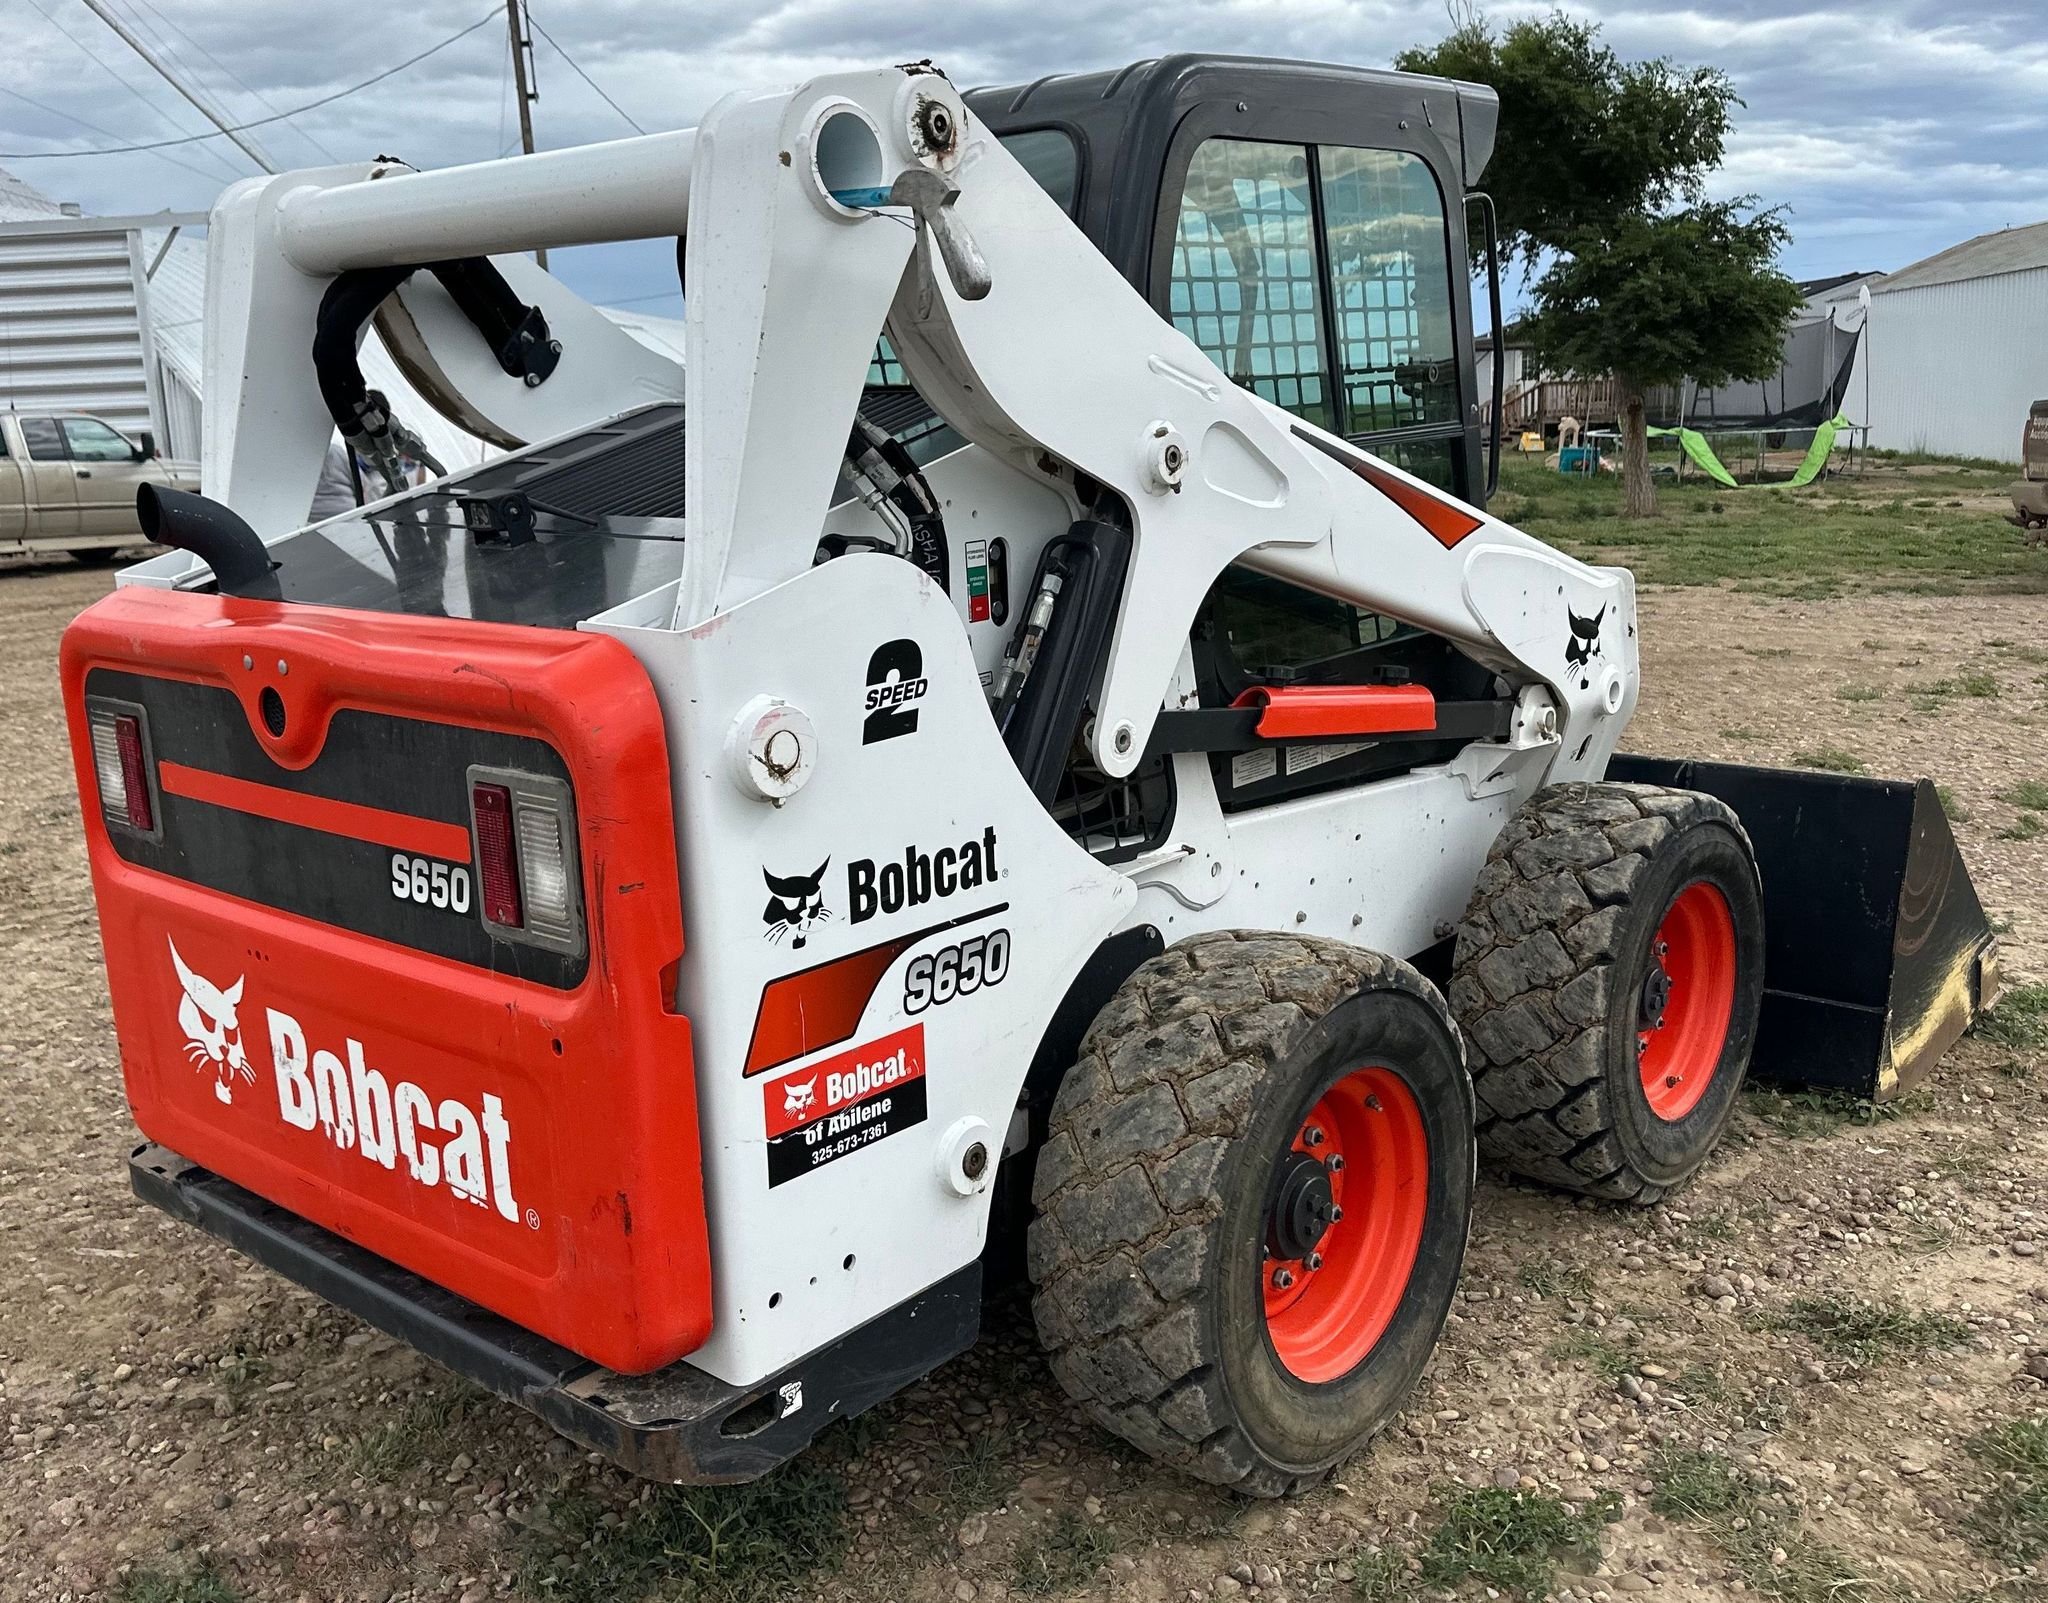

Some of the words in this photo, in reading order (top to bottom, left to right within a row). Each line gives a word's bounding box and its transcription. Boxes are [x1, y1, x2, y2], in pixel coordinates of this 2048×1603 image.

[862, 638, 923, 746] 2
[864, 678, 929, 711] SPEED
[391, 853, 470, 914] S650
[847, 825, 998, 926] Bobcat
[903, 927, 1011, 1016] S650
[826, 1048, 908, 1108] Bobcat
[265, 1006, 520, 1224] Bobcat
[804, 1120, 824, 1146] of
[827, 1097, 892, 1137] Abilene
[811, 1120, 889, 1165] 325-673-7361
